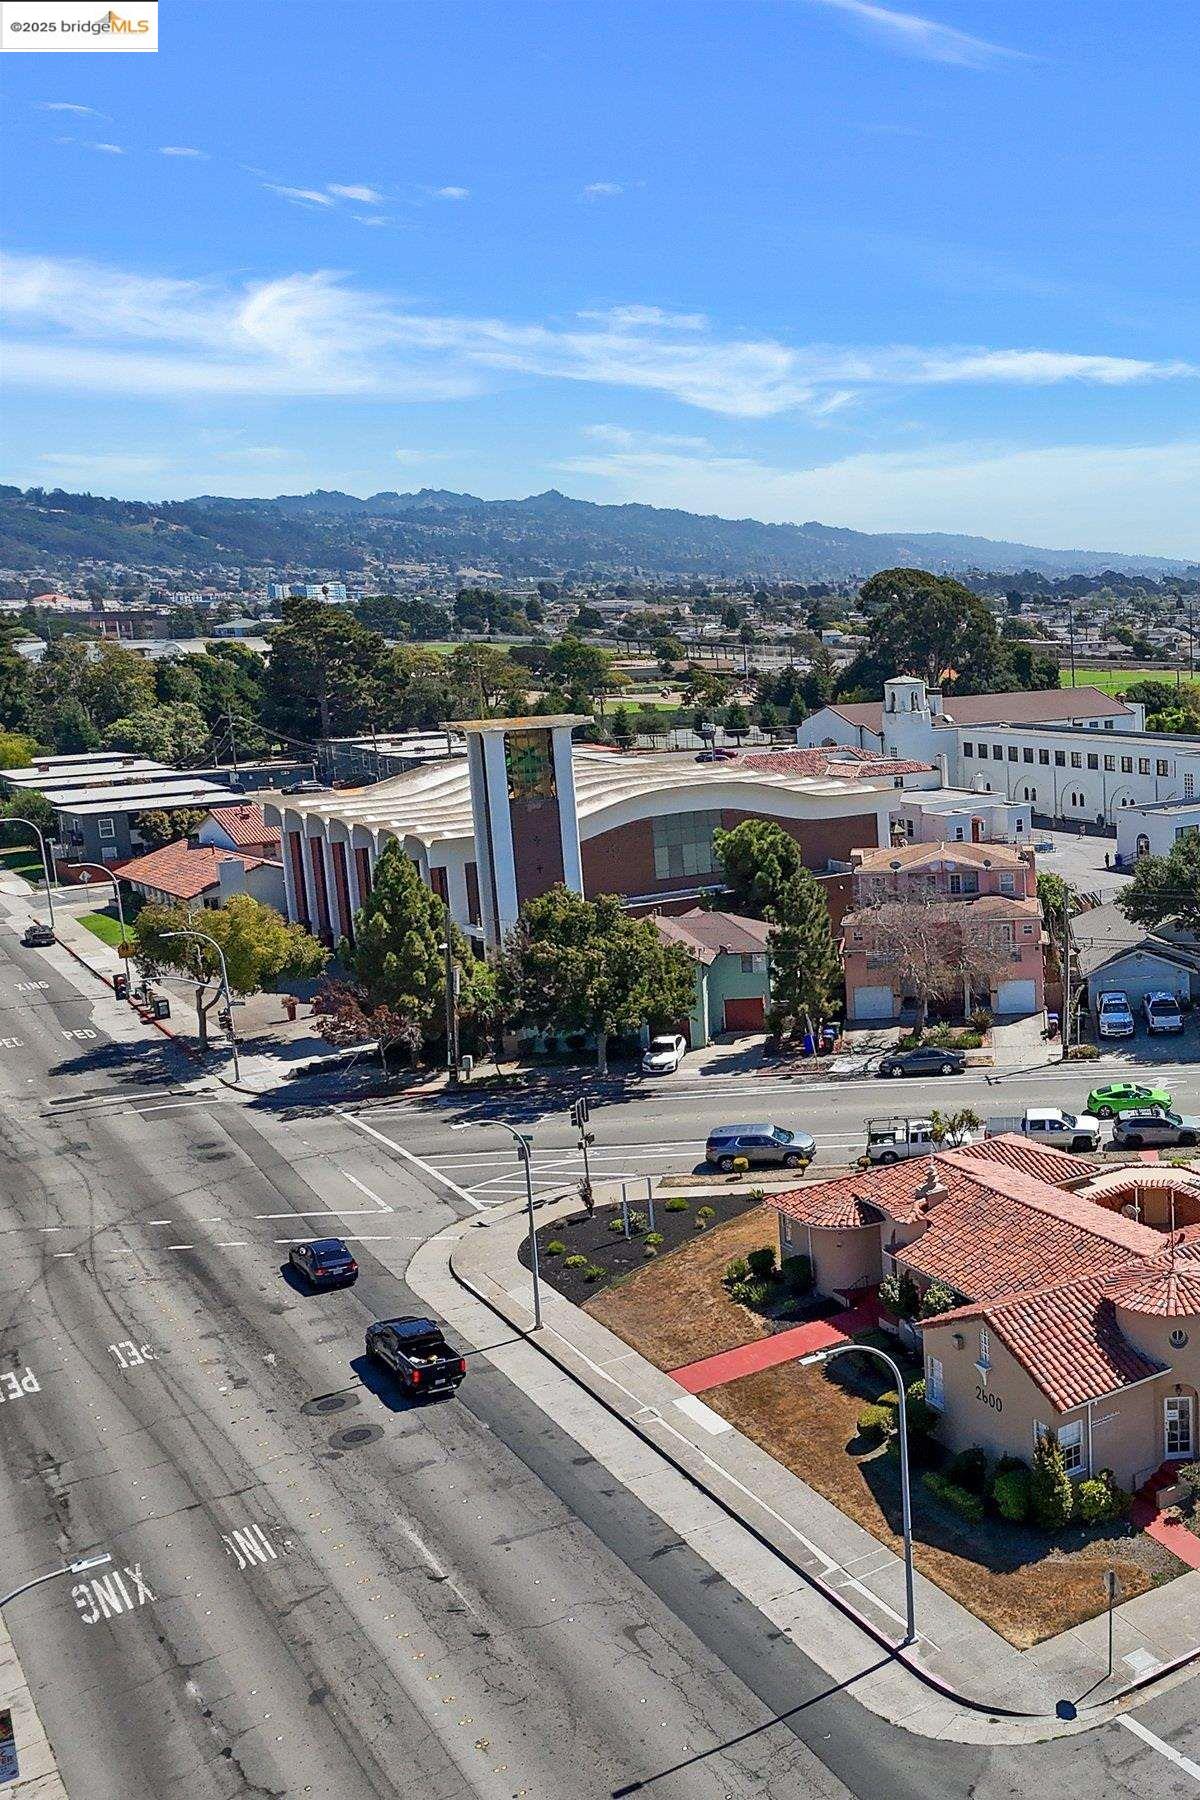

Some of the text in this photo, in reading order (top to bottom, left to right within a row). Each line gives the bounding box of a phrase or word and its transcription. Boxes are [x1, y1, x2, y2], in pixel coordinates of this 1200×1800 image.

[14, 980, 50, 991] XING
[62, 1029, 98, 1041] PED
[0, 1367, 42, 1403] PE
[975, 1385, 1003, 1413] 2600
[71, 1563, 157, 1625] XING
